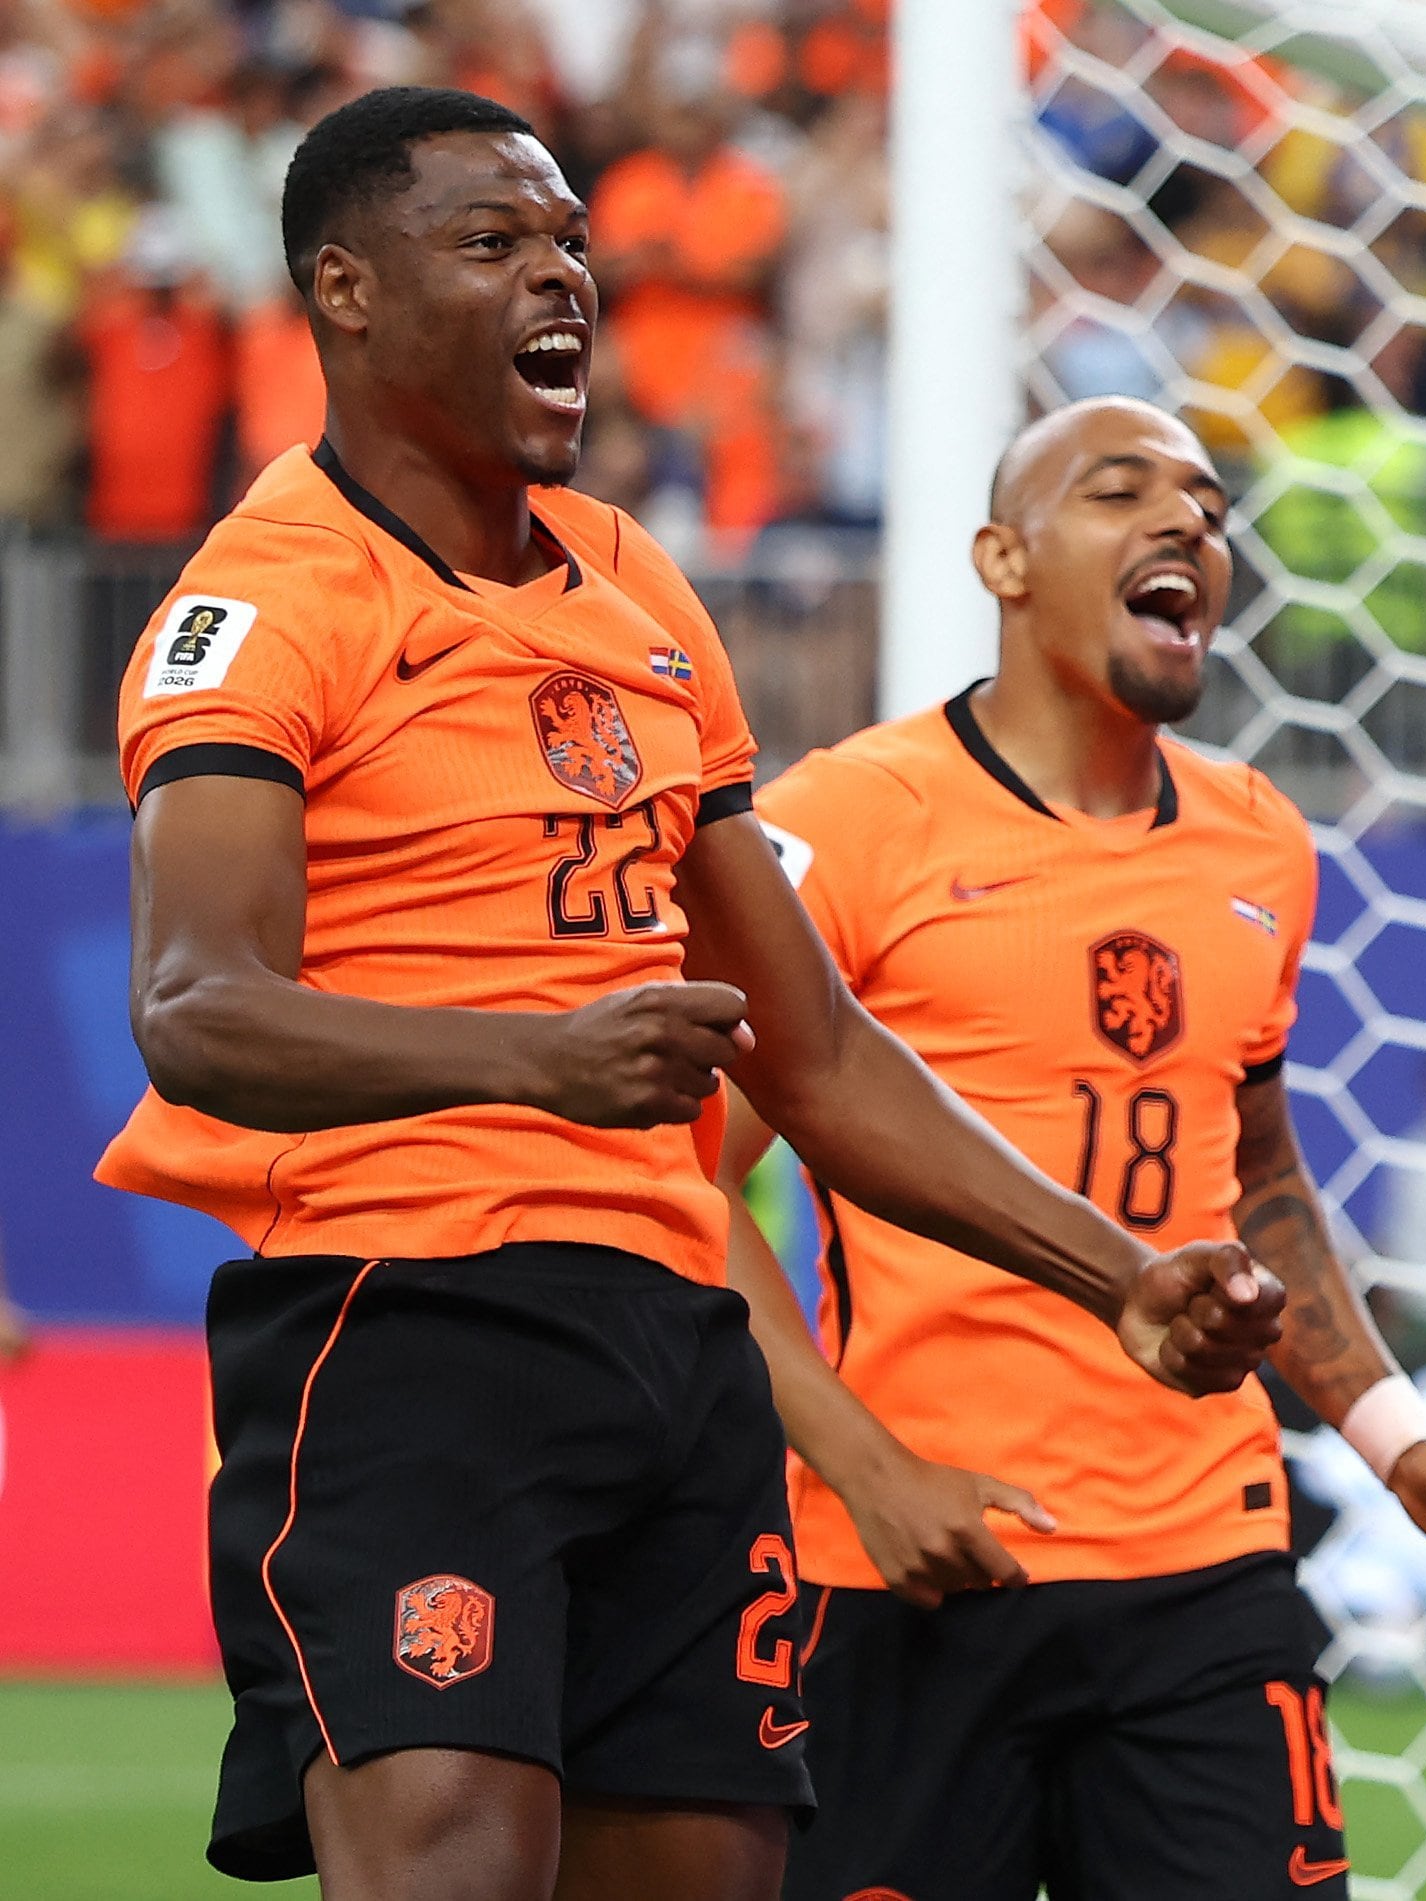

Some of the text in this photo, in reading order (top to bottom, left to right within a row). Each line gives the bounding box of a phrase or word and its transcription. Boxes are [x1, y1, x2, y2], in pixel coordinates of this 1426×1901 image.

[157, 676, 195, 687] 2026
[543, 798, 662, 940] 22
[1072, 1079, 1181, 1233] 18
[736, 1533, 804, 1697] 2
